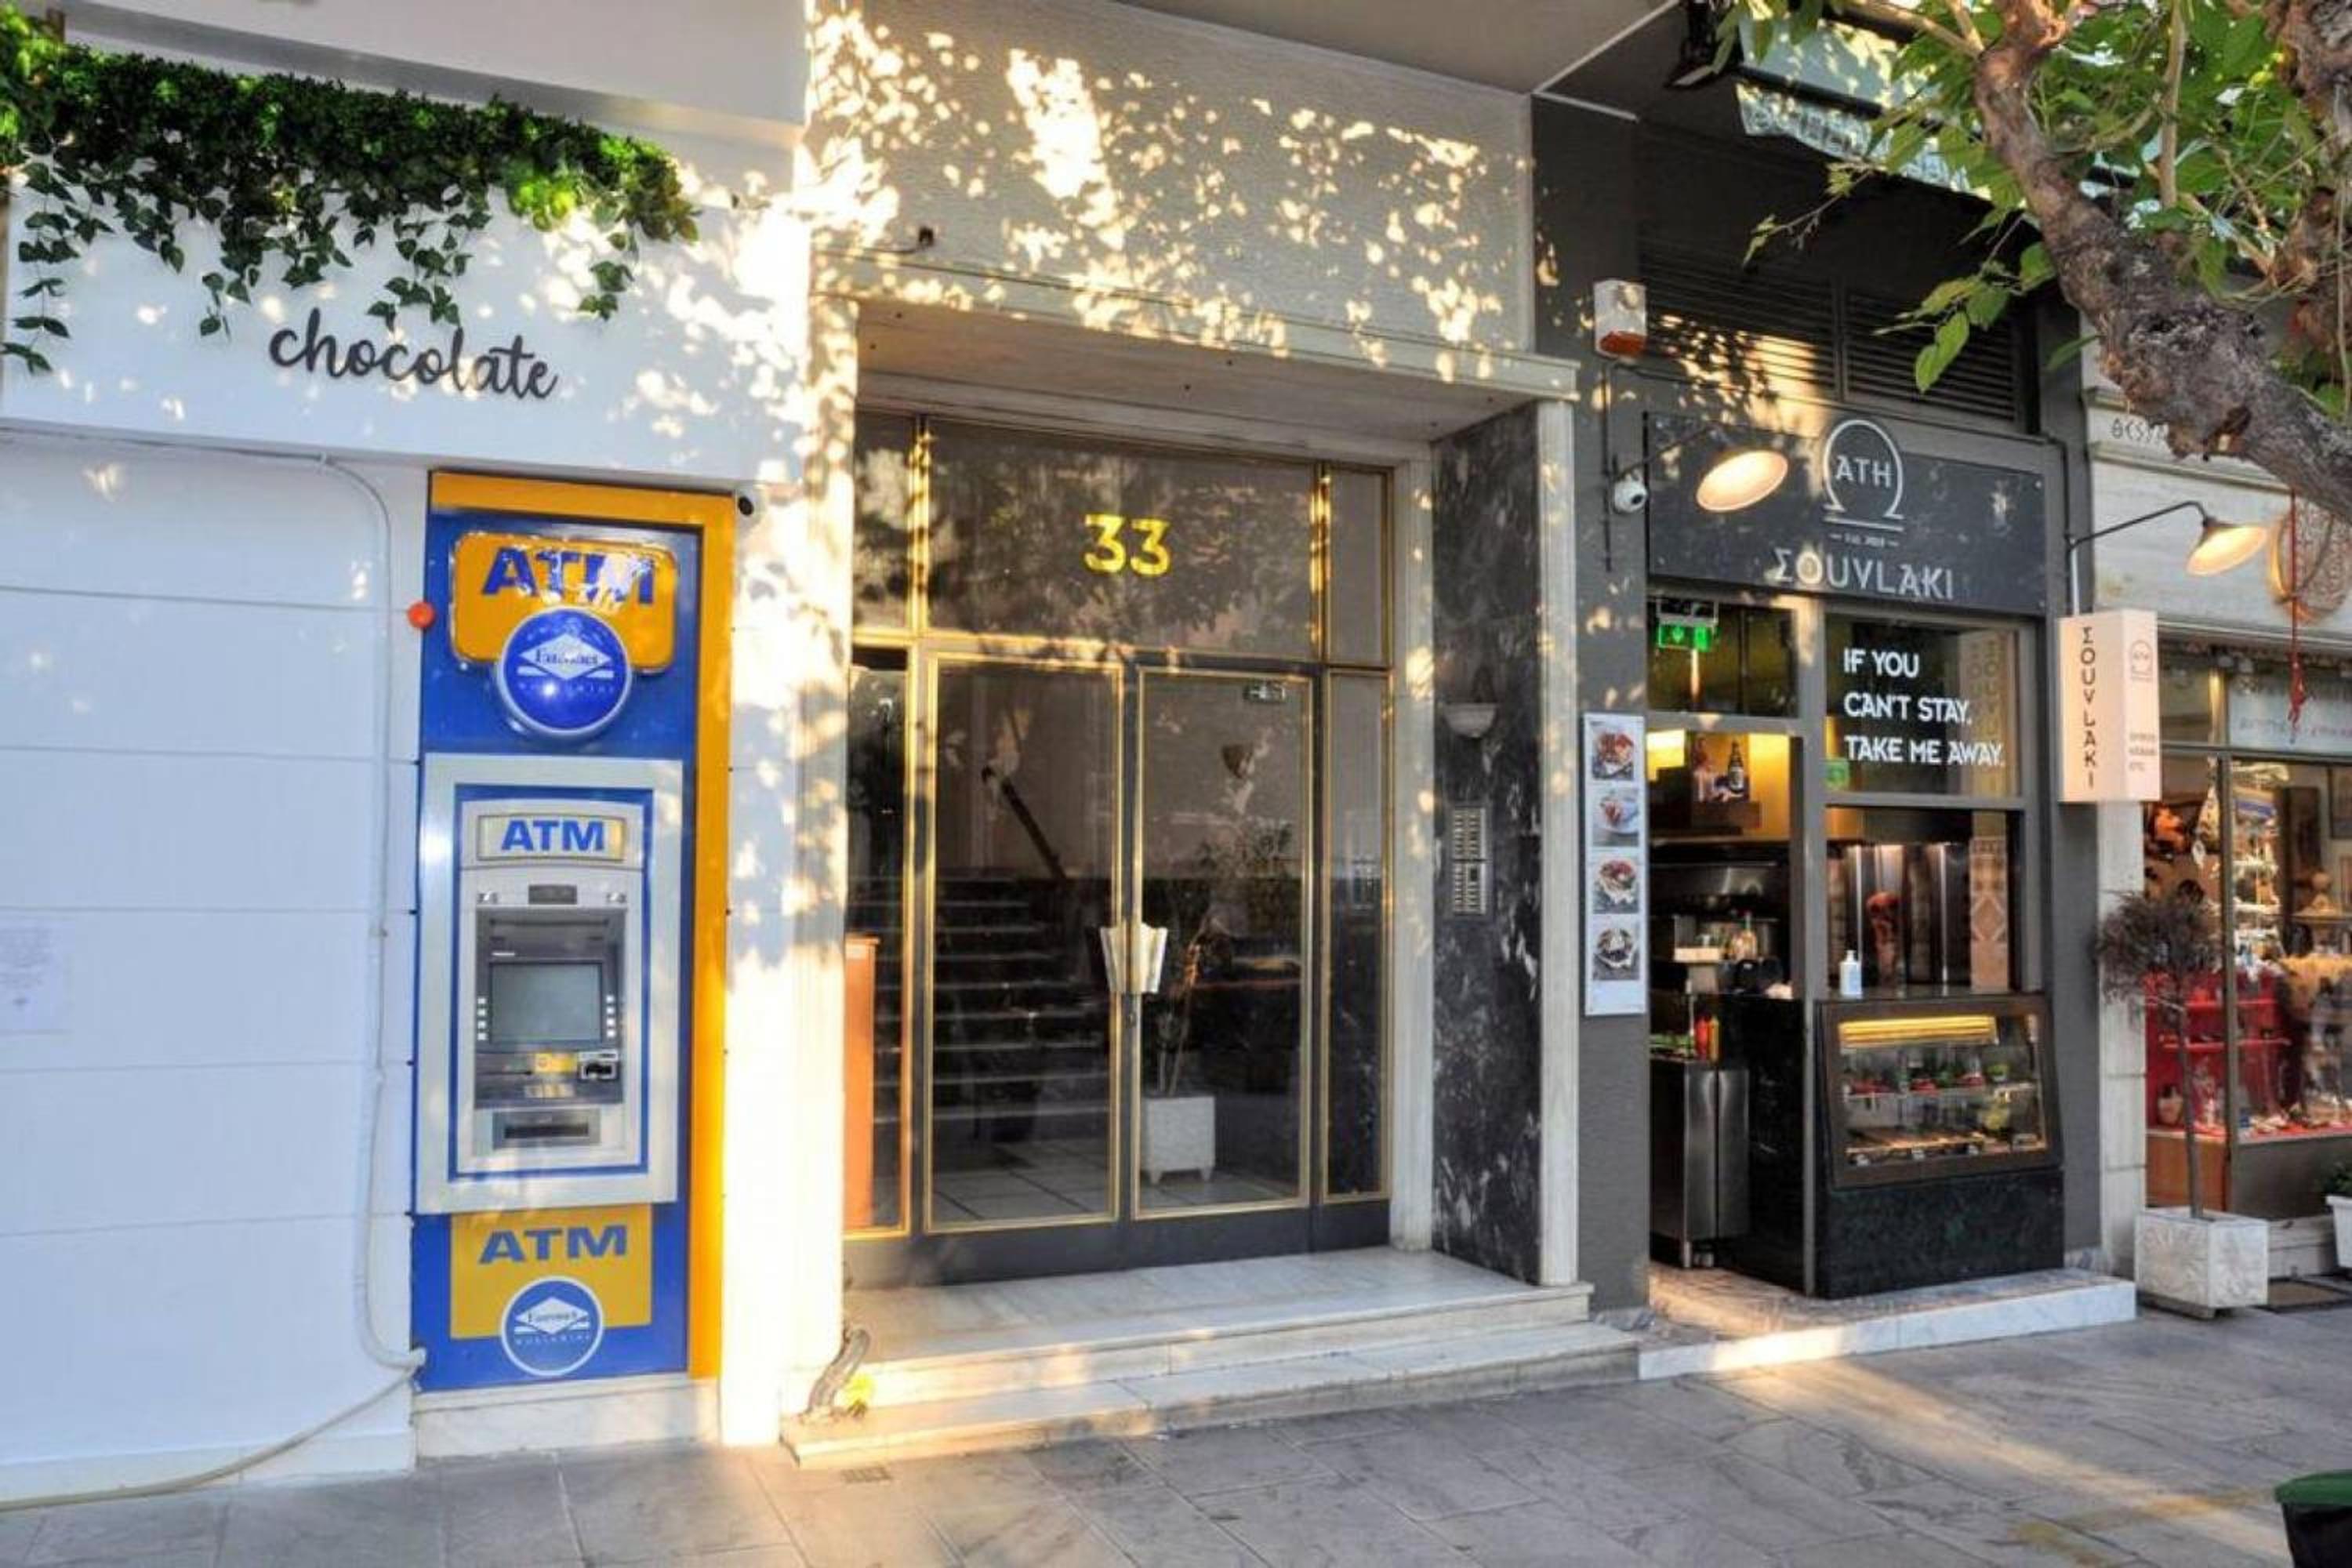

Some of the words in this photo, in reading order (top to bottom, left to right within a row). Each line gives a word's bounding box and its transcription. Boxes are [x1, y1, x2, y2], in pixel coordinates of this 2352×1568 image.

[269, 307, 557, 400] chocolate
[1835, 454, 1893, 488] ATH
[1084, 514, 1171, 577] 33
[481, 546, 655, 605] ATM
[1843, 648, 1866, 674] IF
[1871, 650, 1920, 679] YOU
[1843, 691, 1911, 720] CAN'T
[1844, 735, 1904, 763] TAKE
[1910, 739, 1942, 764] ME
[500, 819, 605, 852] ATM
[478, 1225, 628, 1265] ATM
